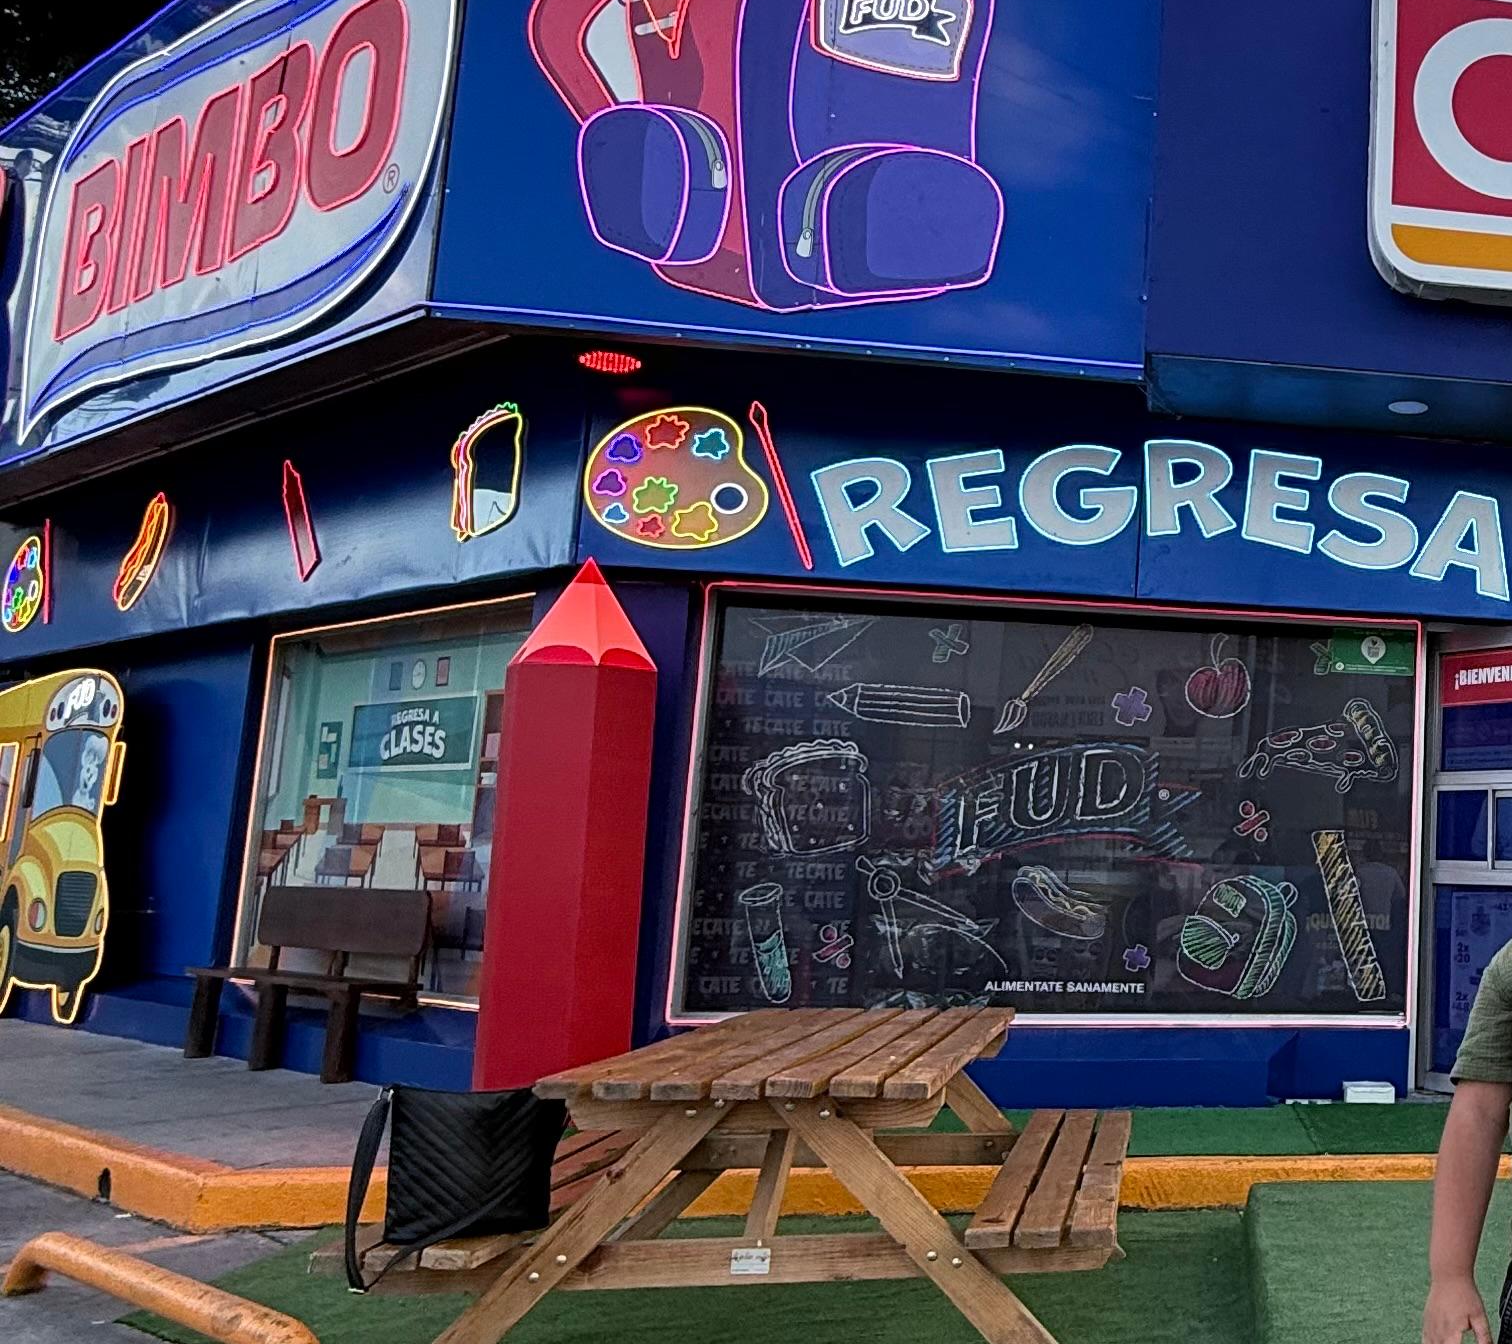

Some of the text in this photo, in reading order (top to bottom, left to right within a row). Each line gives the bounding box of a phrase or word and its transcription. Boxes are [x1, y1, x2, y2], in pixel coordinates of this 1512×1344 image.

[811, 439, 1510, 603] REGRESA
[64, 677, 96, 720] FUD
[391, 708, 440, 727] REGRESA A
[380, 724, 447, 761] CLASES
[953, 748, 1146, 858] FUD
[983, 980, 1146, 994] ALIMENTATE SANAMENTE
